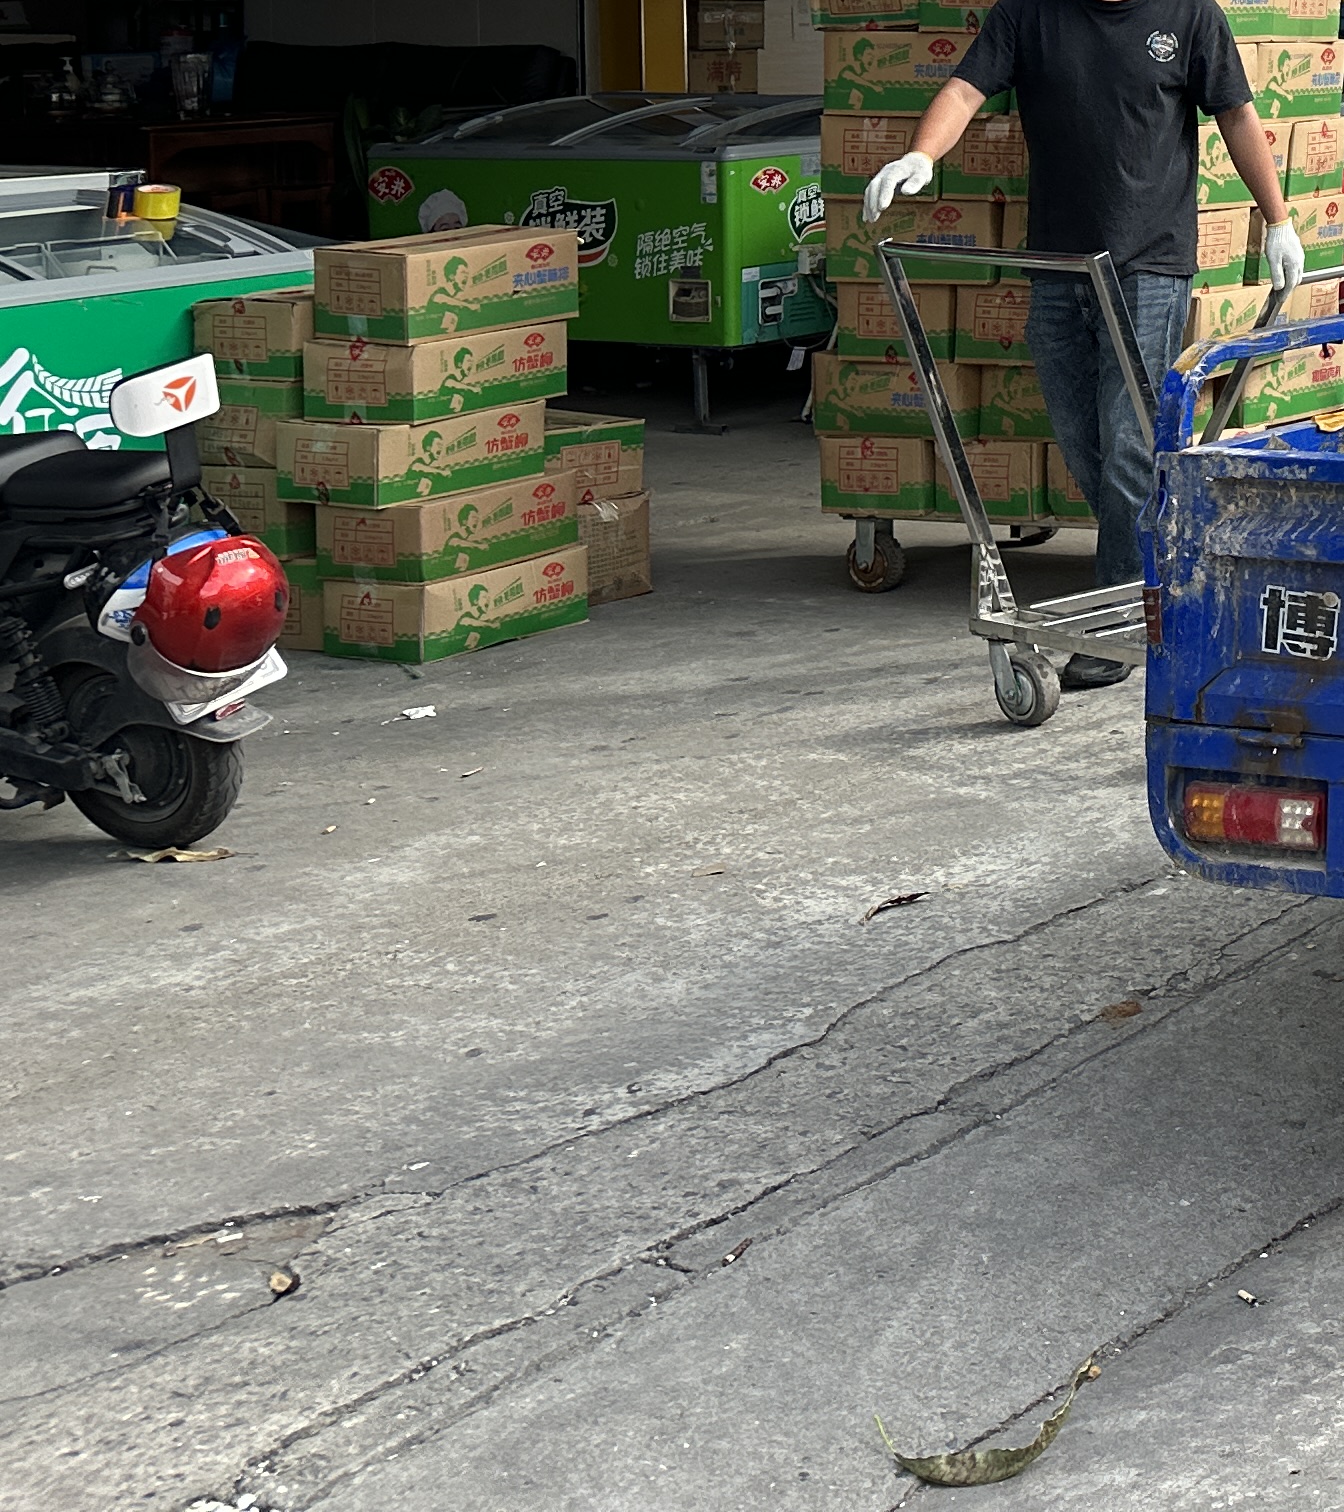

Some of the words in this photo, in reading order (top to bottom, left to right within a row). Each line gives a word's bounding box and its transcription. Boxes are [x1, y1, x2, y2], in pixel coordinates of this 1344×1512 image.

[373, 174, 411, 197] 安井
[757, 174, 784, 190] 安井
[533, 190, 564, 213] 真空
[636, 222, 708, 255] 隔绝空气
[634, 248, 704, 281] 锁住美味
[511, 350, 554, 373] 仿蟹柳
[484, 431, 529, 455] 仿蟹柳
[520, 501, 566, 527] 仿蟹柳
[532, 580, 575, 605] 仿蟹柳
[1259, 584, 1340, 661] 博
